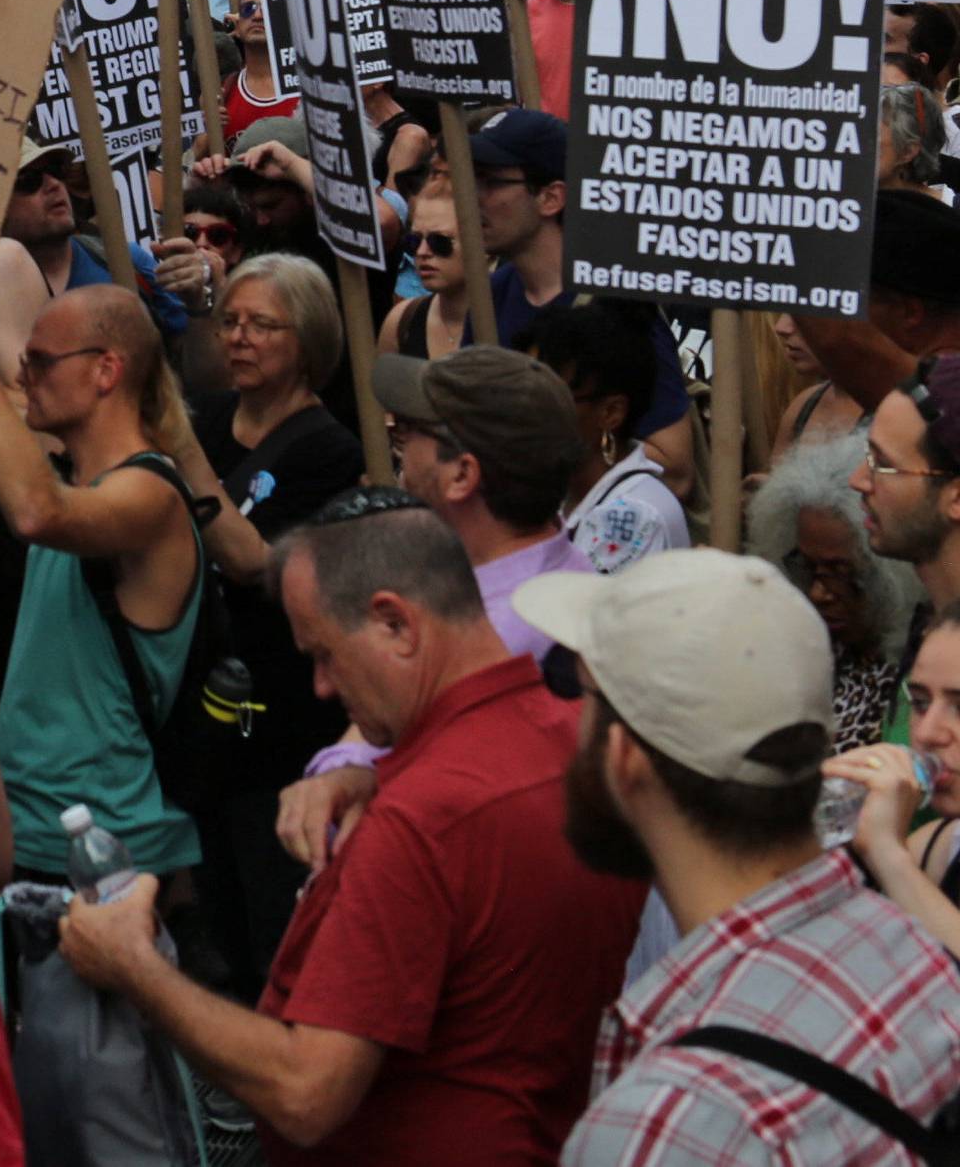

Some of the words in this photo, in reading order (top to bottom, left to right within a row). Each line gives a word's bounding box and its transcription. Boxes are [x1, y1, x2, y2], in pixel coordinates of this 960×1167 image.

[440, 6, 503, 33] UNIDOS
[411, 38, 478, 65] FASCISTA
[584, 66, 610, 99] En
[614, 71, 687, 104] nombre
[691, 75, 714, 105] de
[719, 79, 739, 108] la
[744, 79, 867, 120] humanidad,
[587, 104, 653, 140] NOS
[660, 109, 827, 153] NEGAMOS
[834, 122, 861, 155] A
[600, 142, 751, 187] ACEPTAR
[759, 155, 784, 188] A
[793, 157, 843, 193] UN
[580, 179, 724, 224] ESTADOS
[732, 191, 862, 233] UNIDOS
[637, 221, 795, 266] FASCISTA
[572, 260, 860, 316] RefuseFascism.org
